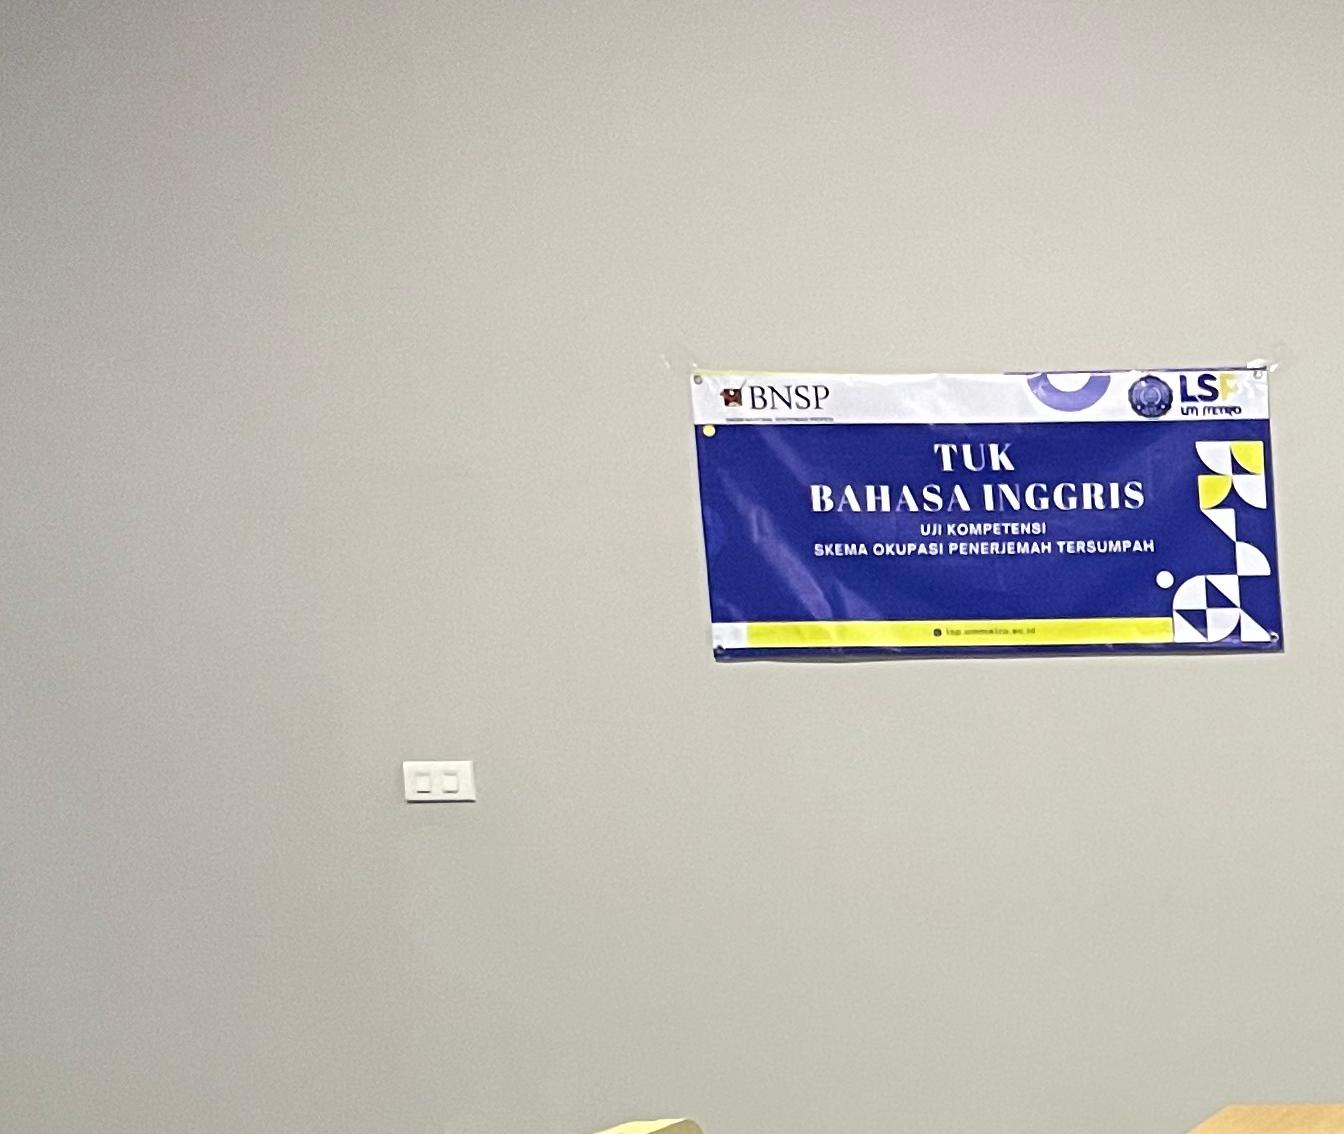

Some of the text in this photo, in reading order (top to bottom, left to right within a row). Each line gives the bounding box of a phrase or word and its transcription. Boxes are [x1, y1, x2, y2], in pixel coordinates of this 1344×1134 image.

[749, 385, 830, 410] BNSP
[934, 443, 1015, 472] TUK
[810, 480, 1146, 513] BAHASA INGGRIS
[920, 521, 1047, 537] UJI KOMPETENSI
[814, 539, 1155, 556] SKEMA OKUPASI PENERJEMAH TERSUMPAH
